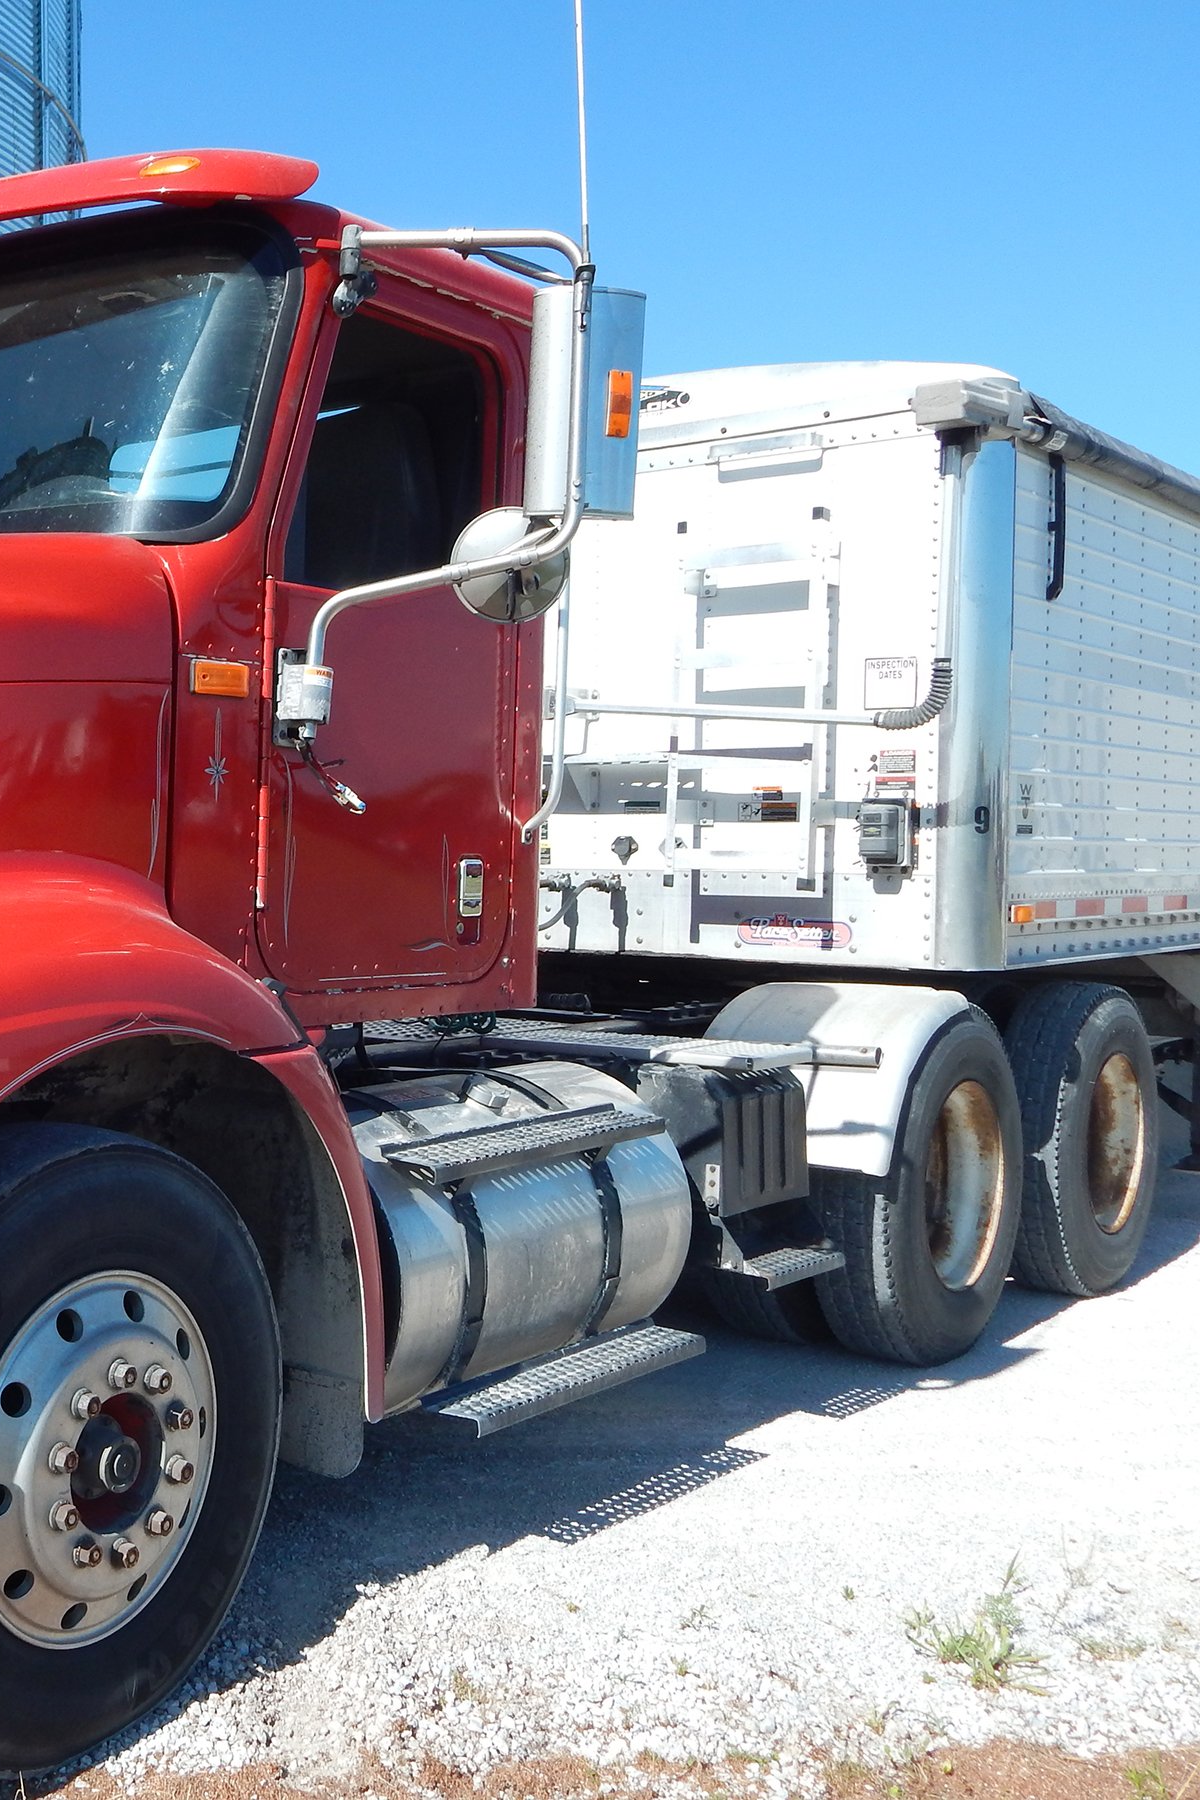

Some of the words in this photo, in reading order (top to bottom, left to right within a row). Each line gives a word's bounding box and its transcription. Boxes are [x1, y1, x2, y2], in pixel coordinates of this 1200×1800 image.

[867, 659, 915, 670] INSPECTION
[878, 670, 903, 680] DATES
[974, 805, 990, 835] 9
